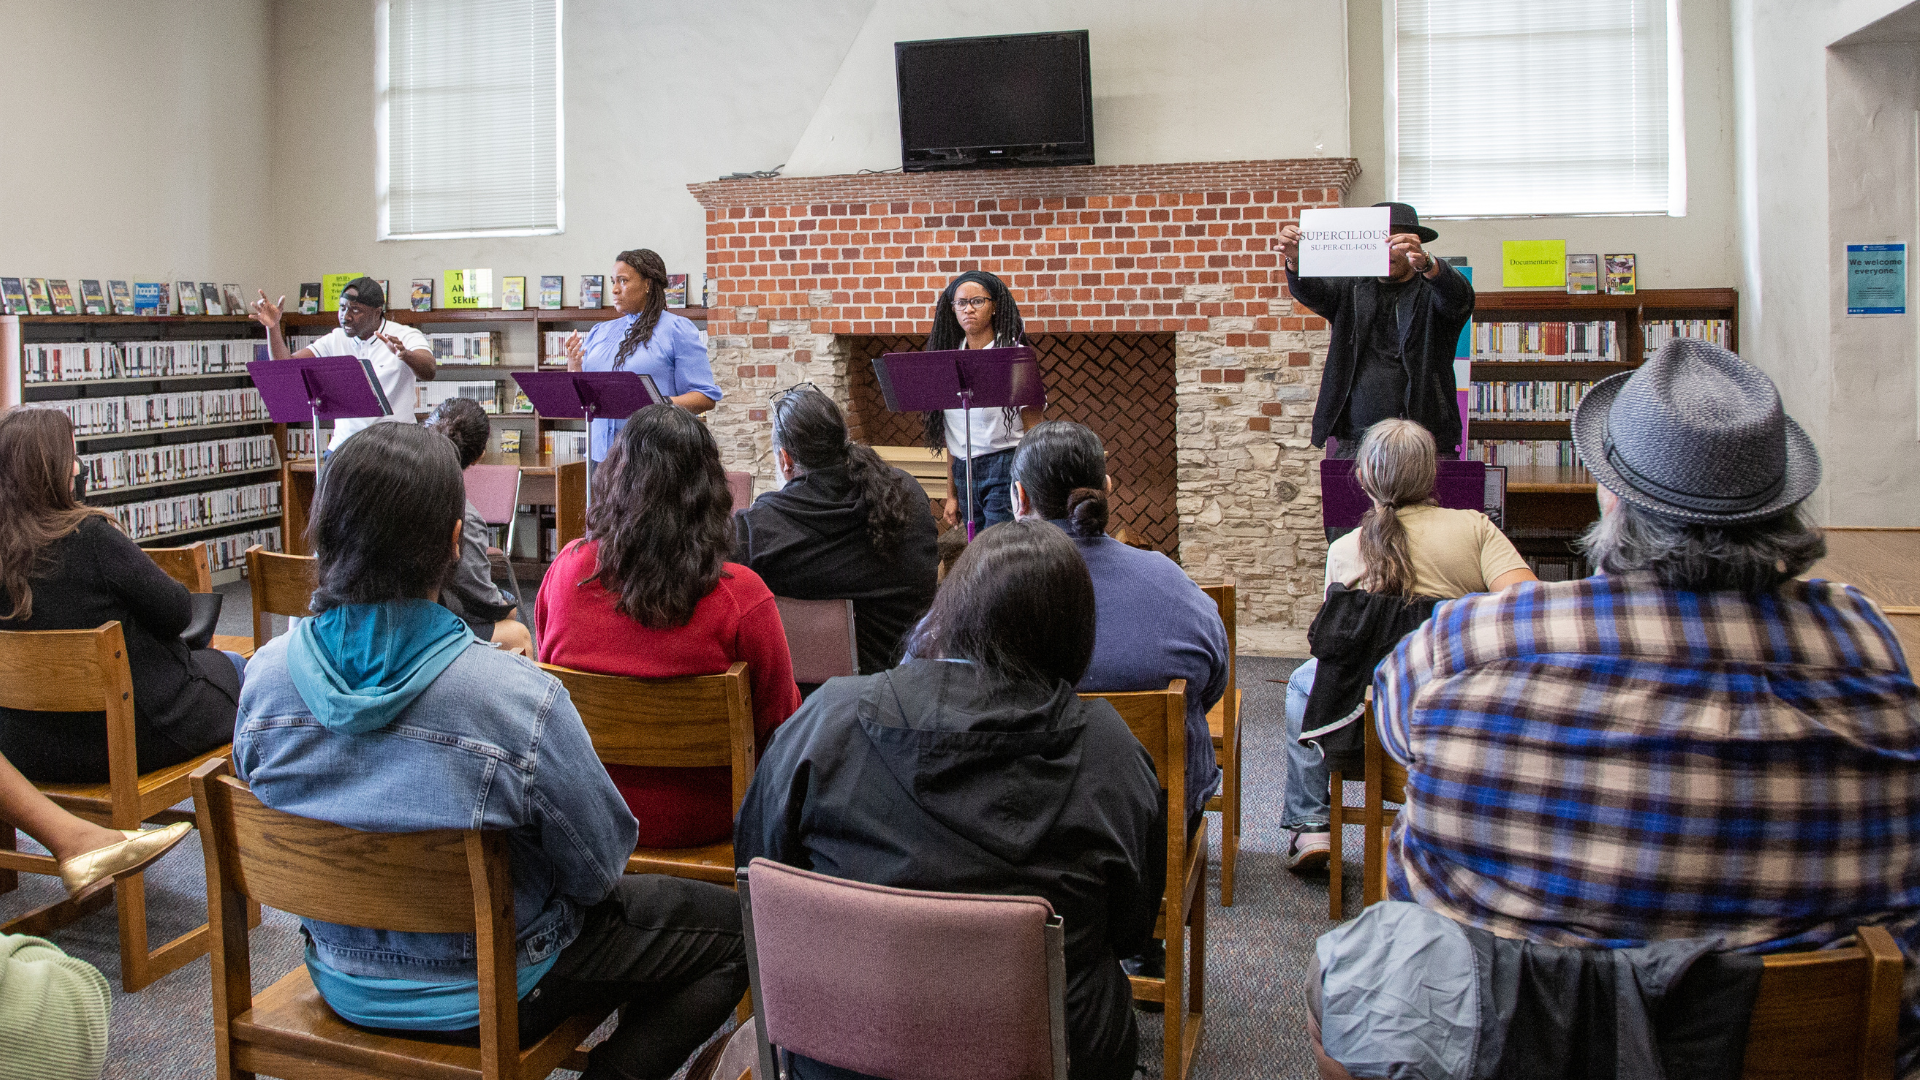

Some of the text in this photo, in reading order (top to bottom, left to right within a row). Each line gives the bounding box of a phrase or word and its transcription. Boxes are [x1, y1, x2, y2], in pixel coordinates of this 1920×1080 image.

[1301, 230, 1388, 241] SUPERCILIOUS
[1509, 258, 1558, 266] Documentaries
[135, 284, 158, 297] hoopla
[453, 296, 480, 304] SERIES
